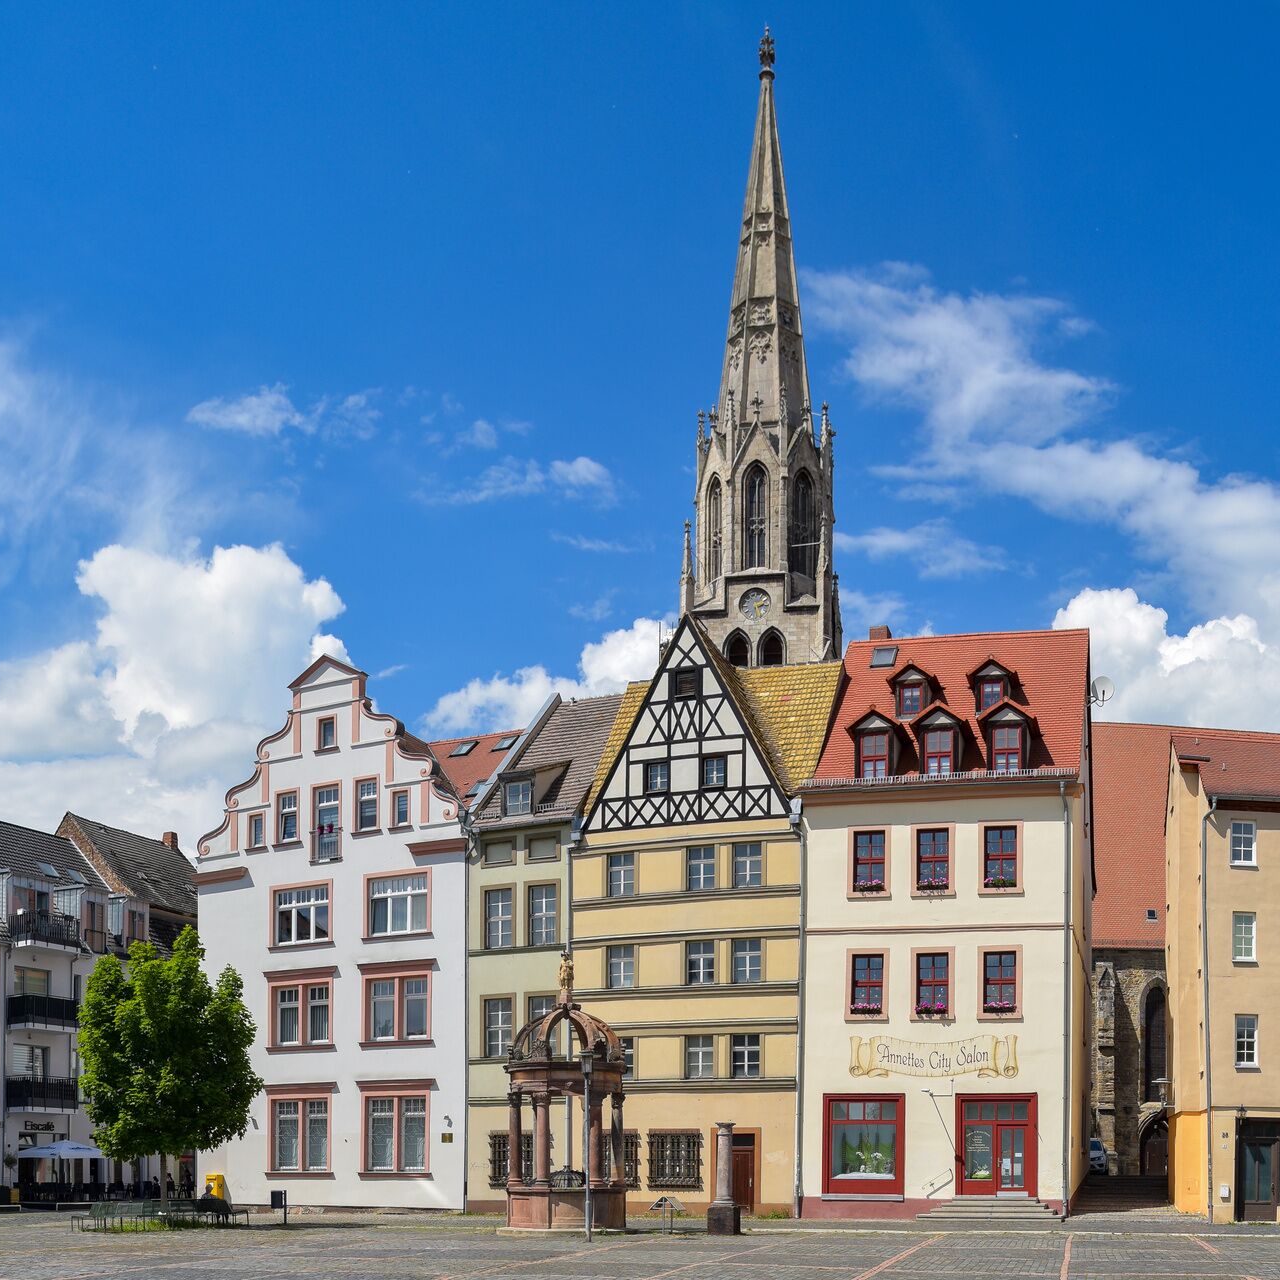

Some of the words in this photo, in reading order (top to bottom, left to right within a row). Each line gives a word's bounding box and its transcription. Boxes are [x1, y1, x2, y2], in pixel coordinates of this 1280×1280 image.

[877, 1043, 925, 1069] Annettes
[929, 1051, 951, 1072] City
[956, 1045, 989, 1066] Salon
[24, 1121, 55, 1131] Eiscafé
